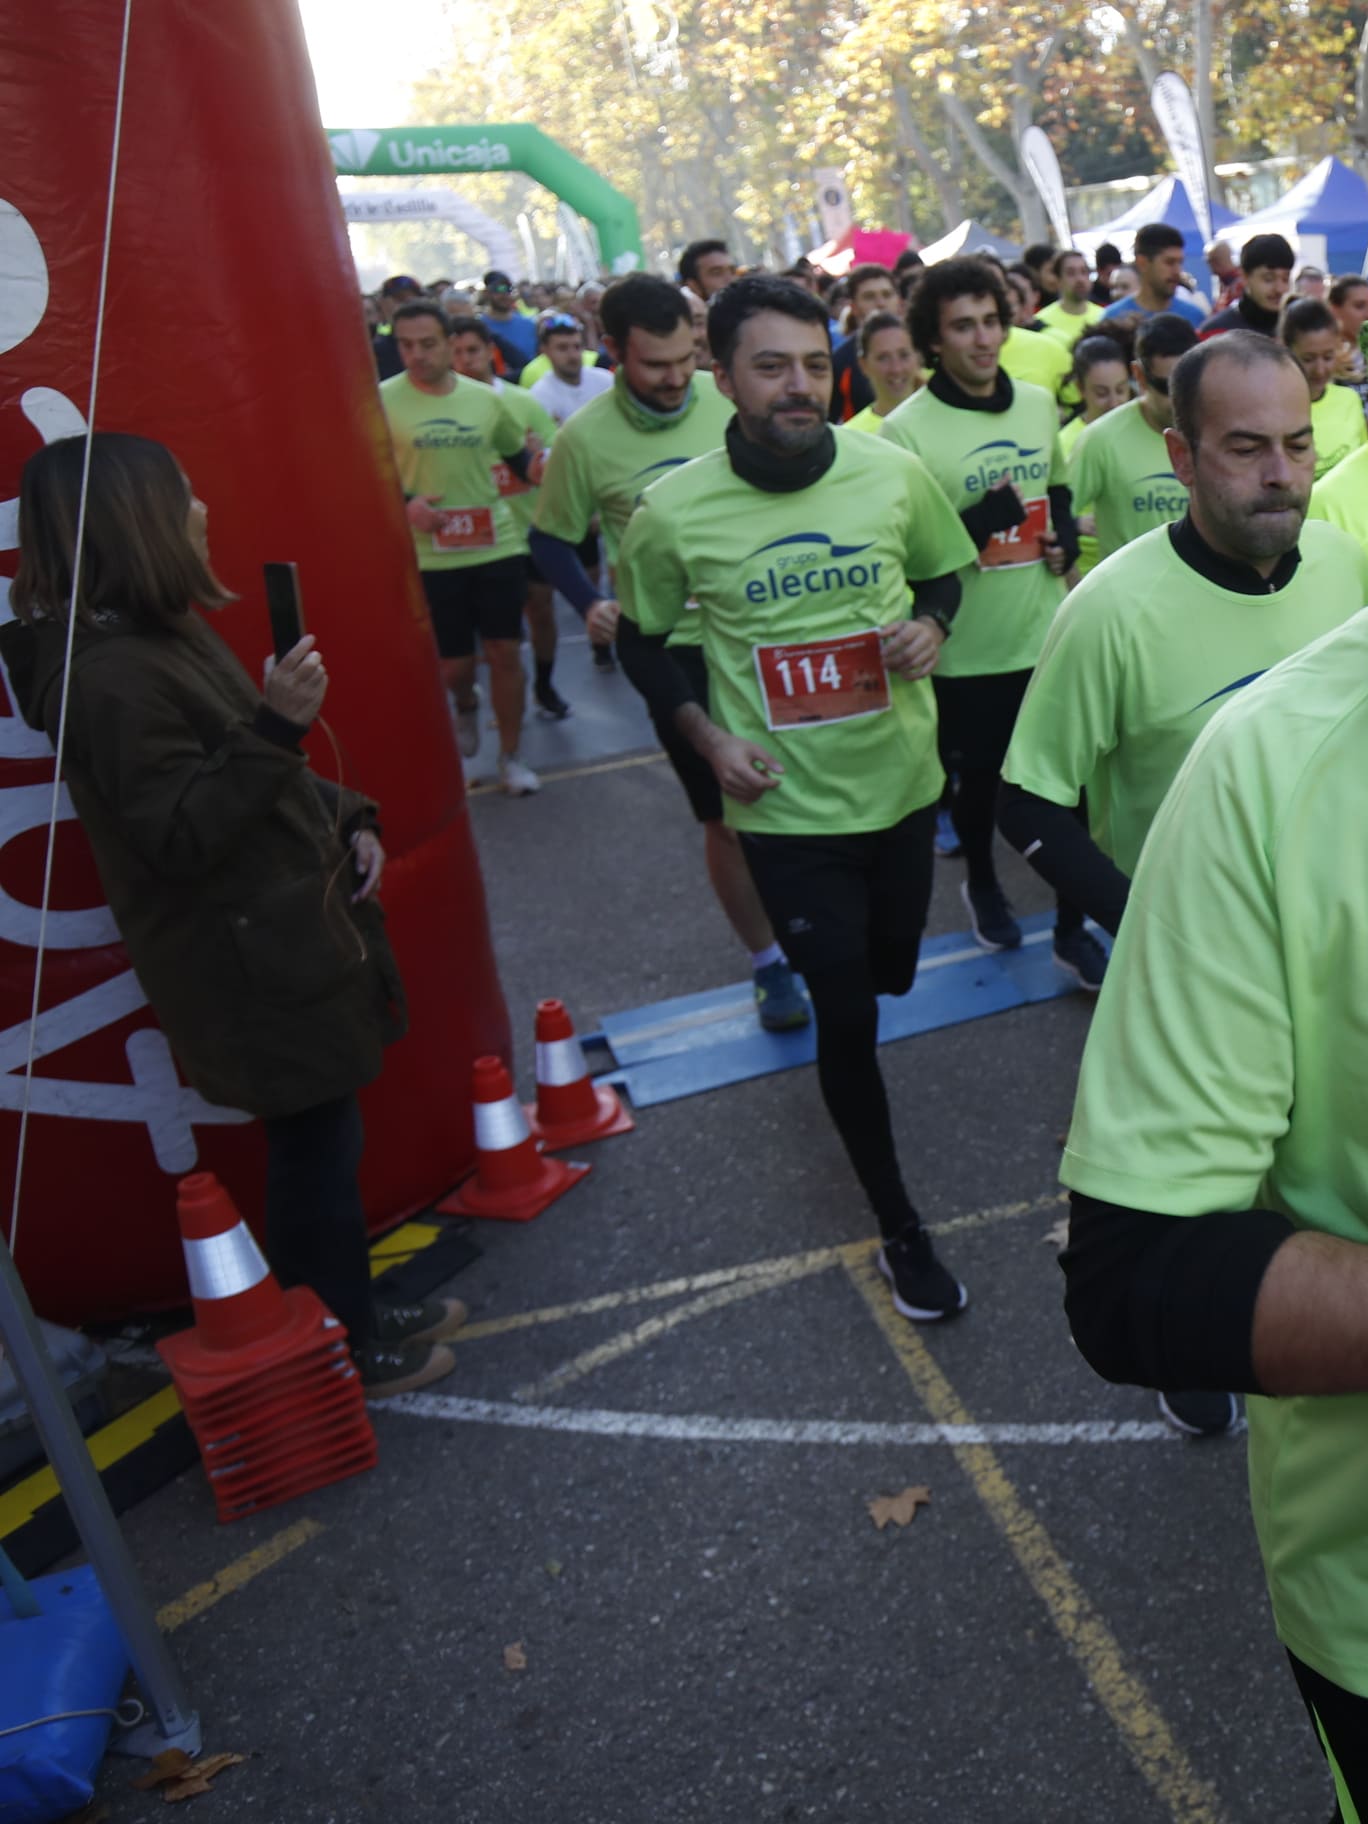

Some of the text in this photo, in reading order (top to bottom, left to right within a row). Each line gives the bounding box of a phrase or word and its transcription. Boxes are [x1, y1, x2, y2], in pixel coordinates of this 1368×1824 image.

[387, 138, 511, 171] Unicaja
[776, 552, 818, 569] grupo
[746, 562, 882, 603] elecnor
[776, 653, 842, 697] 114
